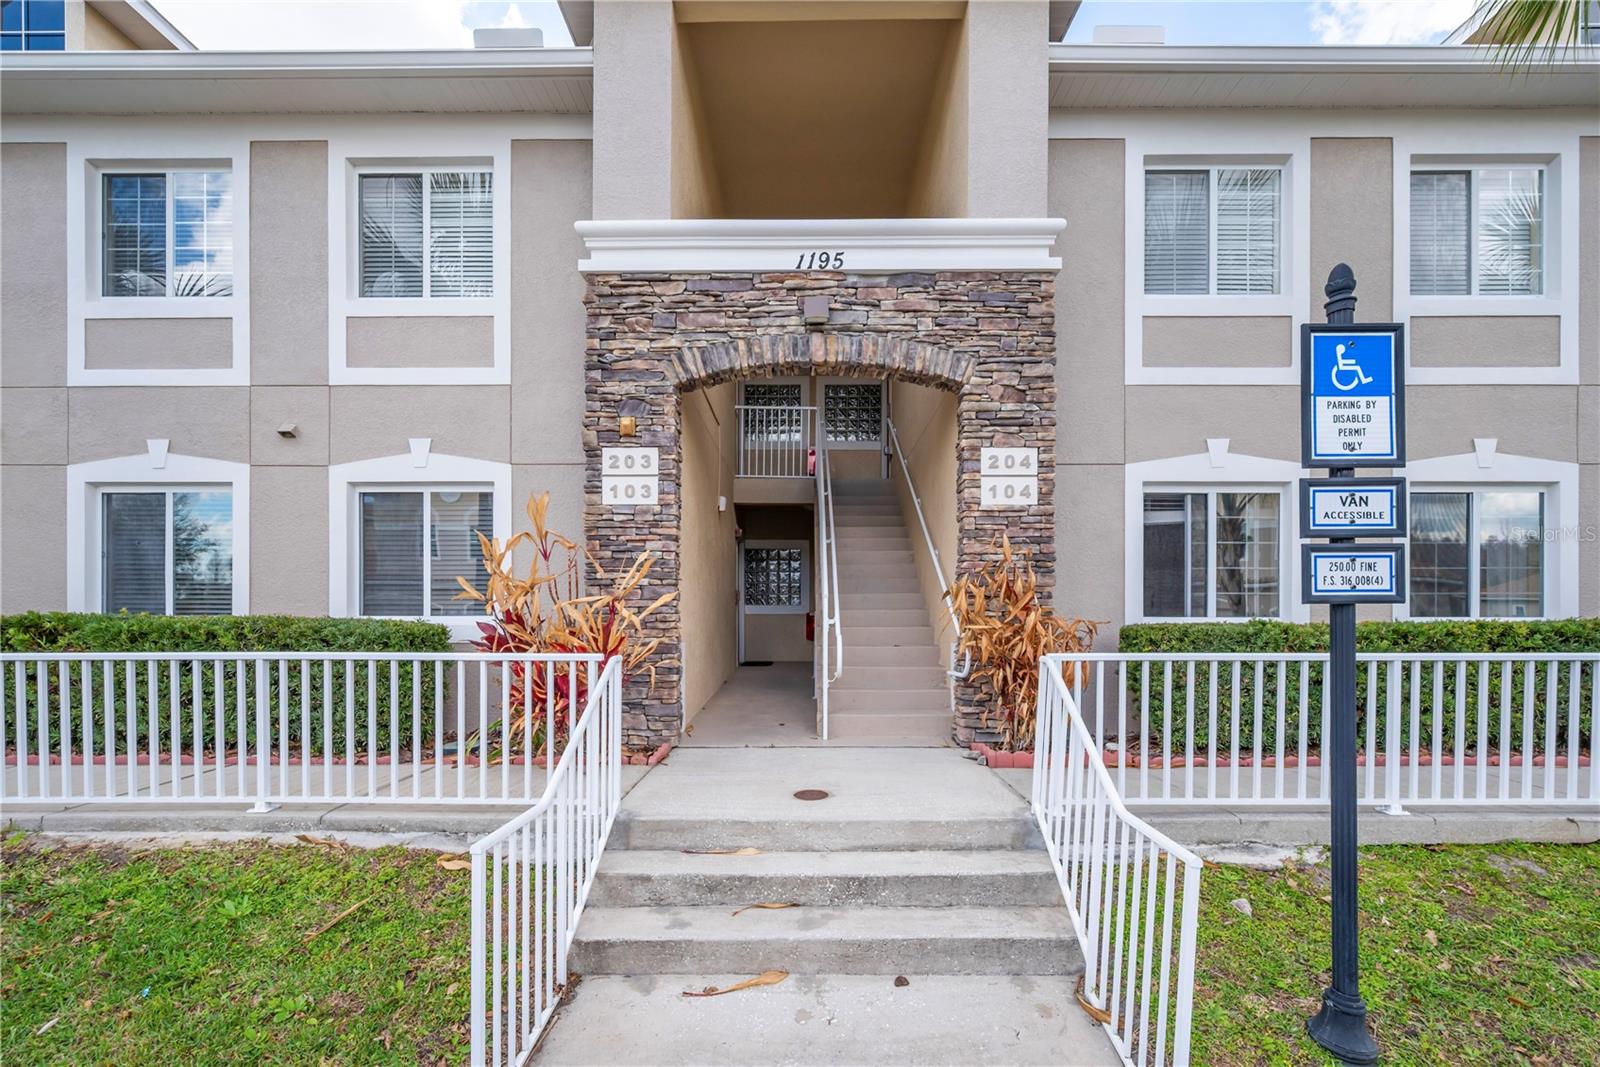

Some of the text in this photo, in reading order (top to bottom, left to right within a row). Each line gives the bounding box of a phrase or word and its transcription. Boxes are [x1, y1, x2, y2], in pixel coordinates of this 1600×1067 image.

[795, 251, 845, 270] 1195
[1326, 400, 1377, 410] PARKING BY
[1332, 414, 1372, 424] DISABLED
[1338, 427, 1366, 437] PERMIT
[1342, 441, 1363, 451] ONLY
[608, 454, 651, 469] 203
[987, 454, 1031, 469] 204
[609, 484, 651, 499] 103
[988, 484, 1031, 499] 104
[1339, 495, 1369, 507] VAN
[1323, 511, 1385, 520] ACCESSIBLE
[1360, 561, 1377, 572] FINE
